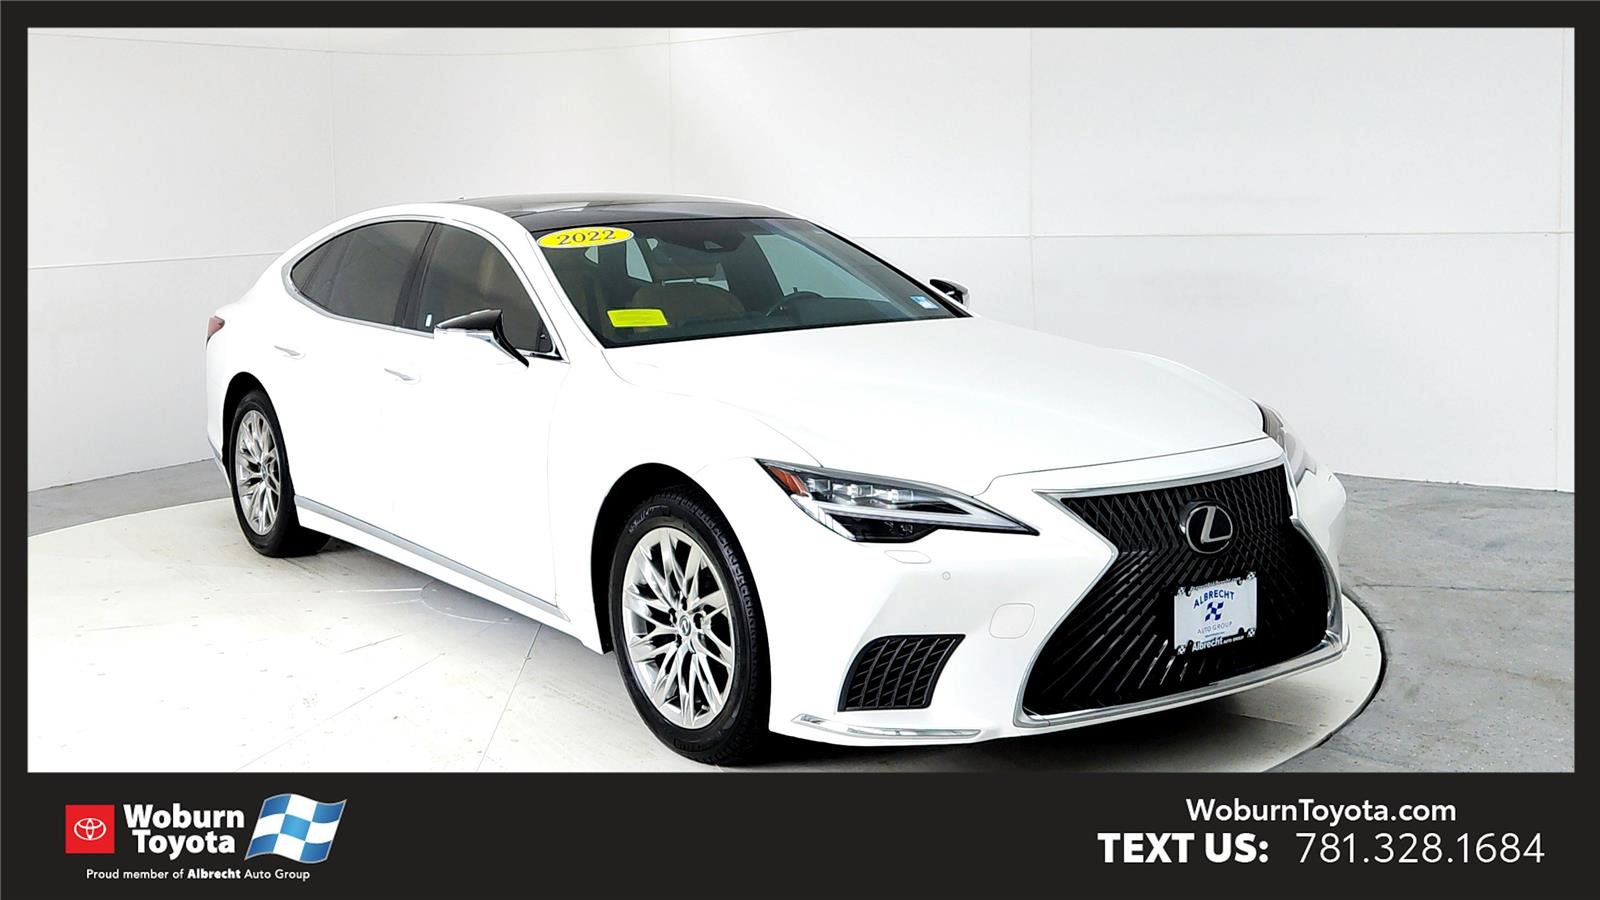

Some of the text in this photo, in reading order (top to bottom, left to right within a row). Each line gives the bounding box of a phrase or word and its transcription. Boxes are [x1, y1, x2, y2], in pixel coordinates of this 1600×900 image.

[557, 229, 617, 246] 2022
[1193, 589, 1235, 609] ALBRECHT
[1197, 624, 1212, 635] AUTO
[1212, 621, 1233, 632] GROUP
[1191, 636, 1223, 652] Albrecht
